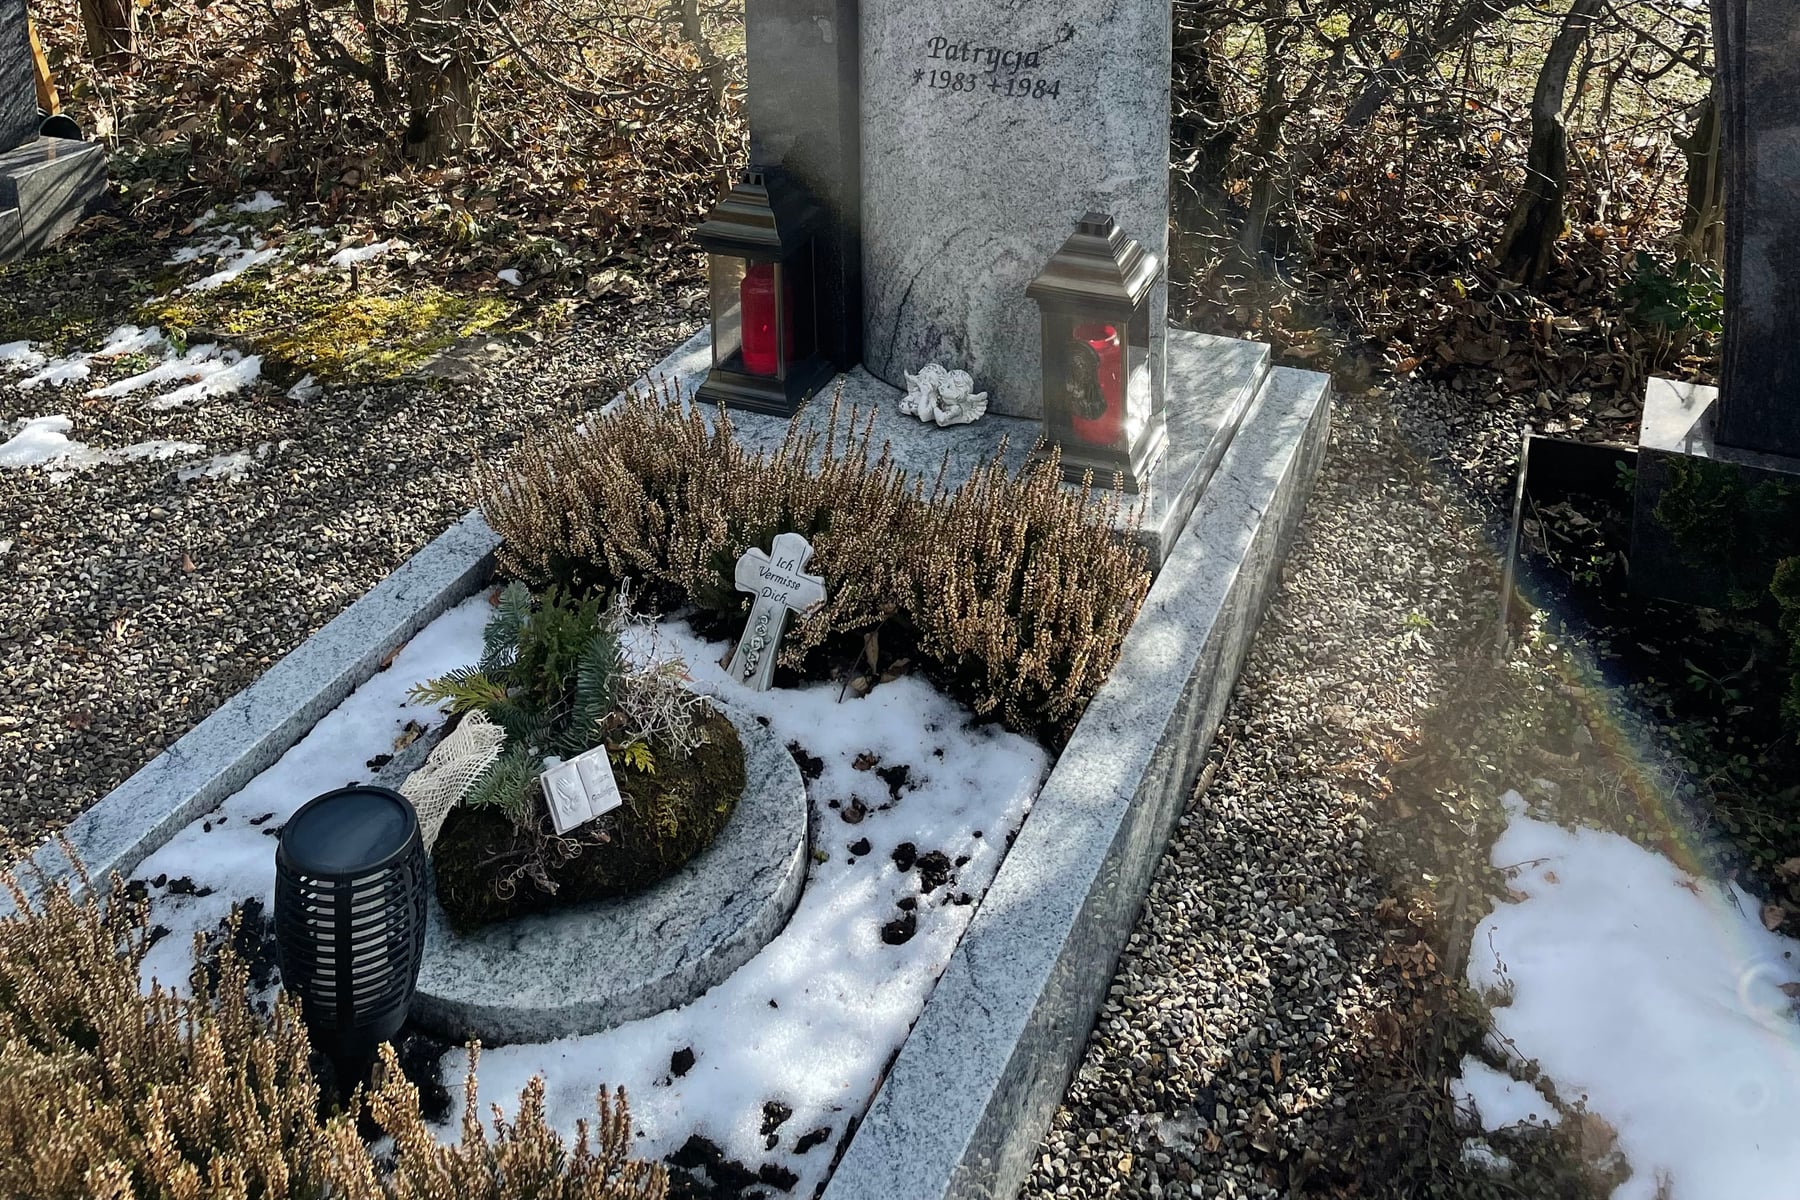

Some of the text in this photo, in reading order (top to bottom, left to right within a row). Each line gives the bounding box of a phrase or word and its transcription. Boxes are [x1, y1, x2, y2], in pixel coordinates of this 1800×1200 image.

[927, 36, 1041, 75] Patrycja
[776, 557, 795, 572] Ich
[759, 566, 801, 590] Vermisse
[761, 586, 788, 604] Dich
